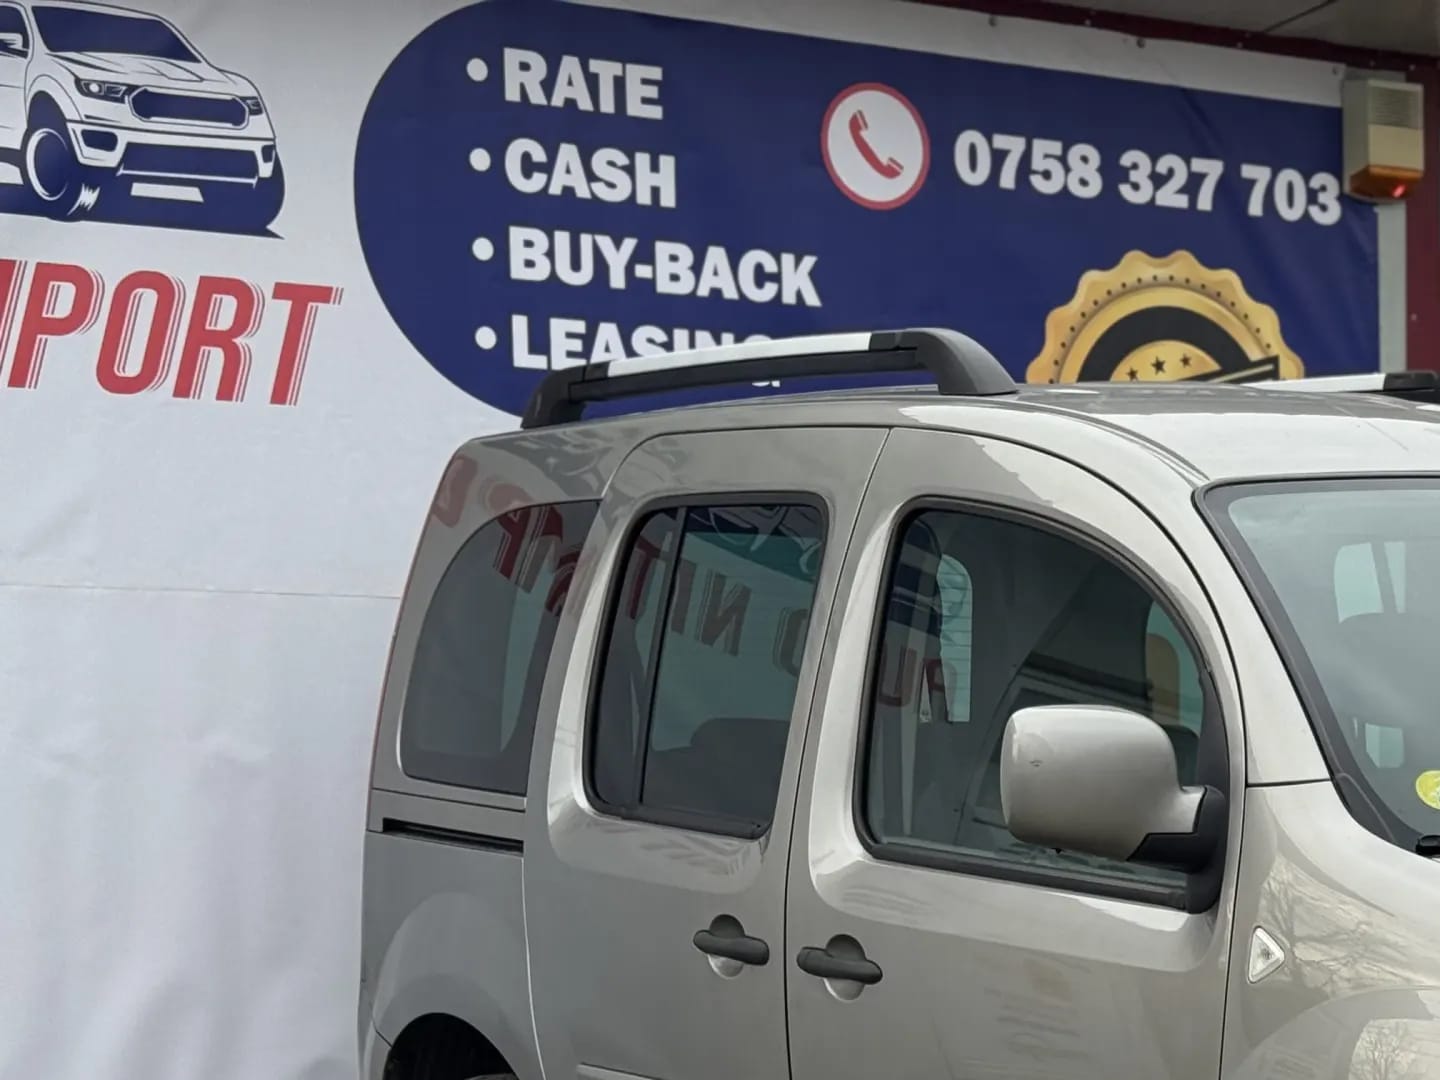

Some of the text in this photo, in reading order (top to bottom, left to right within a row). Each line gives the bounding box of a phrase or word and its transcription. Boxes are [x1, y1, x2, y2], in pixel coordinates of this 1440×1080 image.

[504, 47, 663, 120] RATE
[505, 137, 676, 208] CASH
[953, 129, 1342, 227] 0758 327 703
[509, 226, 822, 307] BUY-BACK
[0, 258, 344, 407] PORT
